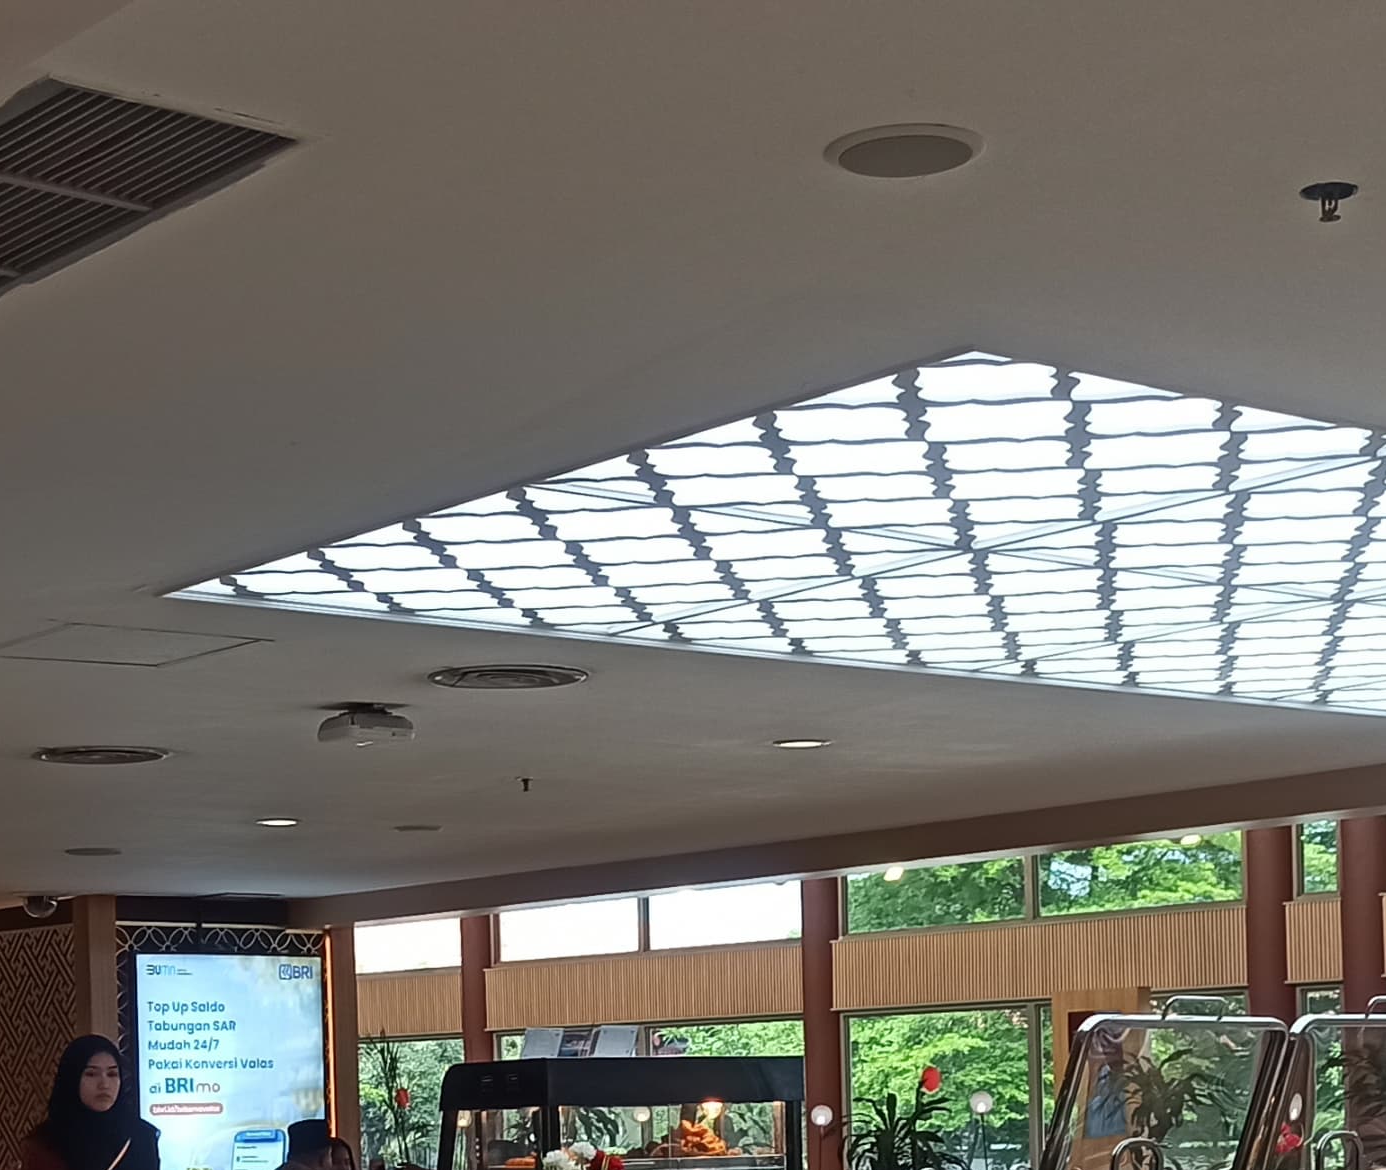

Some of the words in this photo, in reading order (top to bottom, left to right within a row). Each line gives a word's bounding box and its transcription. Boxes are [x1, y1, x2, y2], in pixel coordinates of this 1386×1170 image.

[292, 965, 313, 979] BRI
[147, 1001, 170, 1015] Top
[172, 1001, 189, 1015] Up
[191, 1001, 226, 1013] Saldo
[147, 1020, 211, 1035] Tabungan
[212, 1020, 237, 1032] SAR
[148, 1040, 191, 1050] Mudah
[193, 1037, 220, 1052] 24/7
[148, 1058, 183, 1070] Pakai
[185, 1057, 238, 1069] Konversi
[240, 1058, 274, 1069] Valas
[149, 1082, 161, 1094] di
